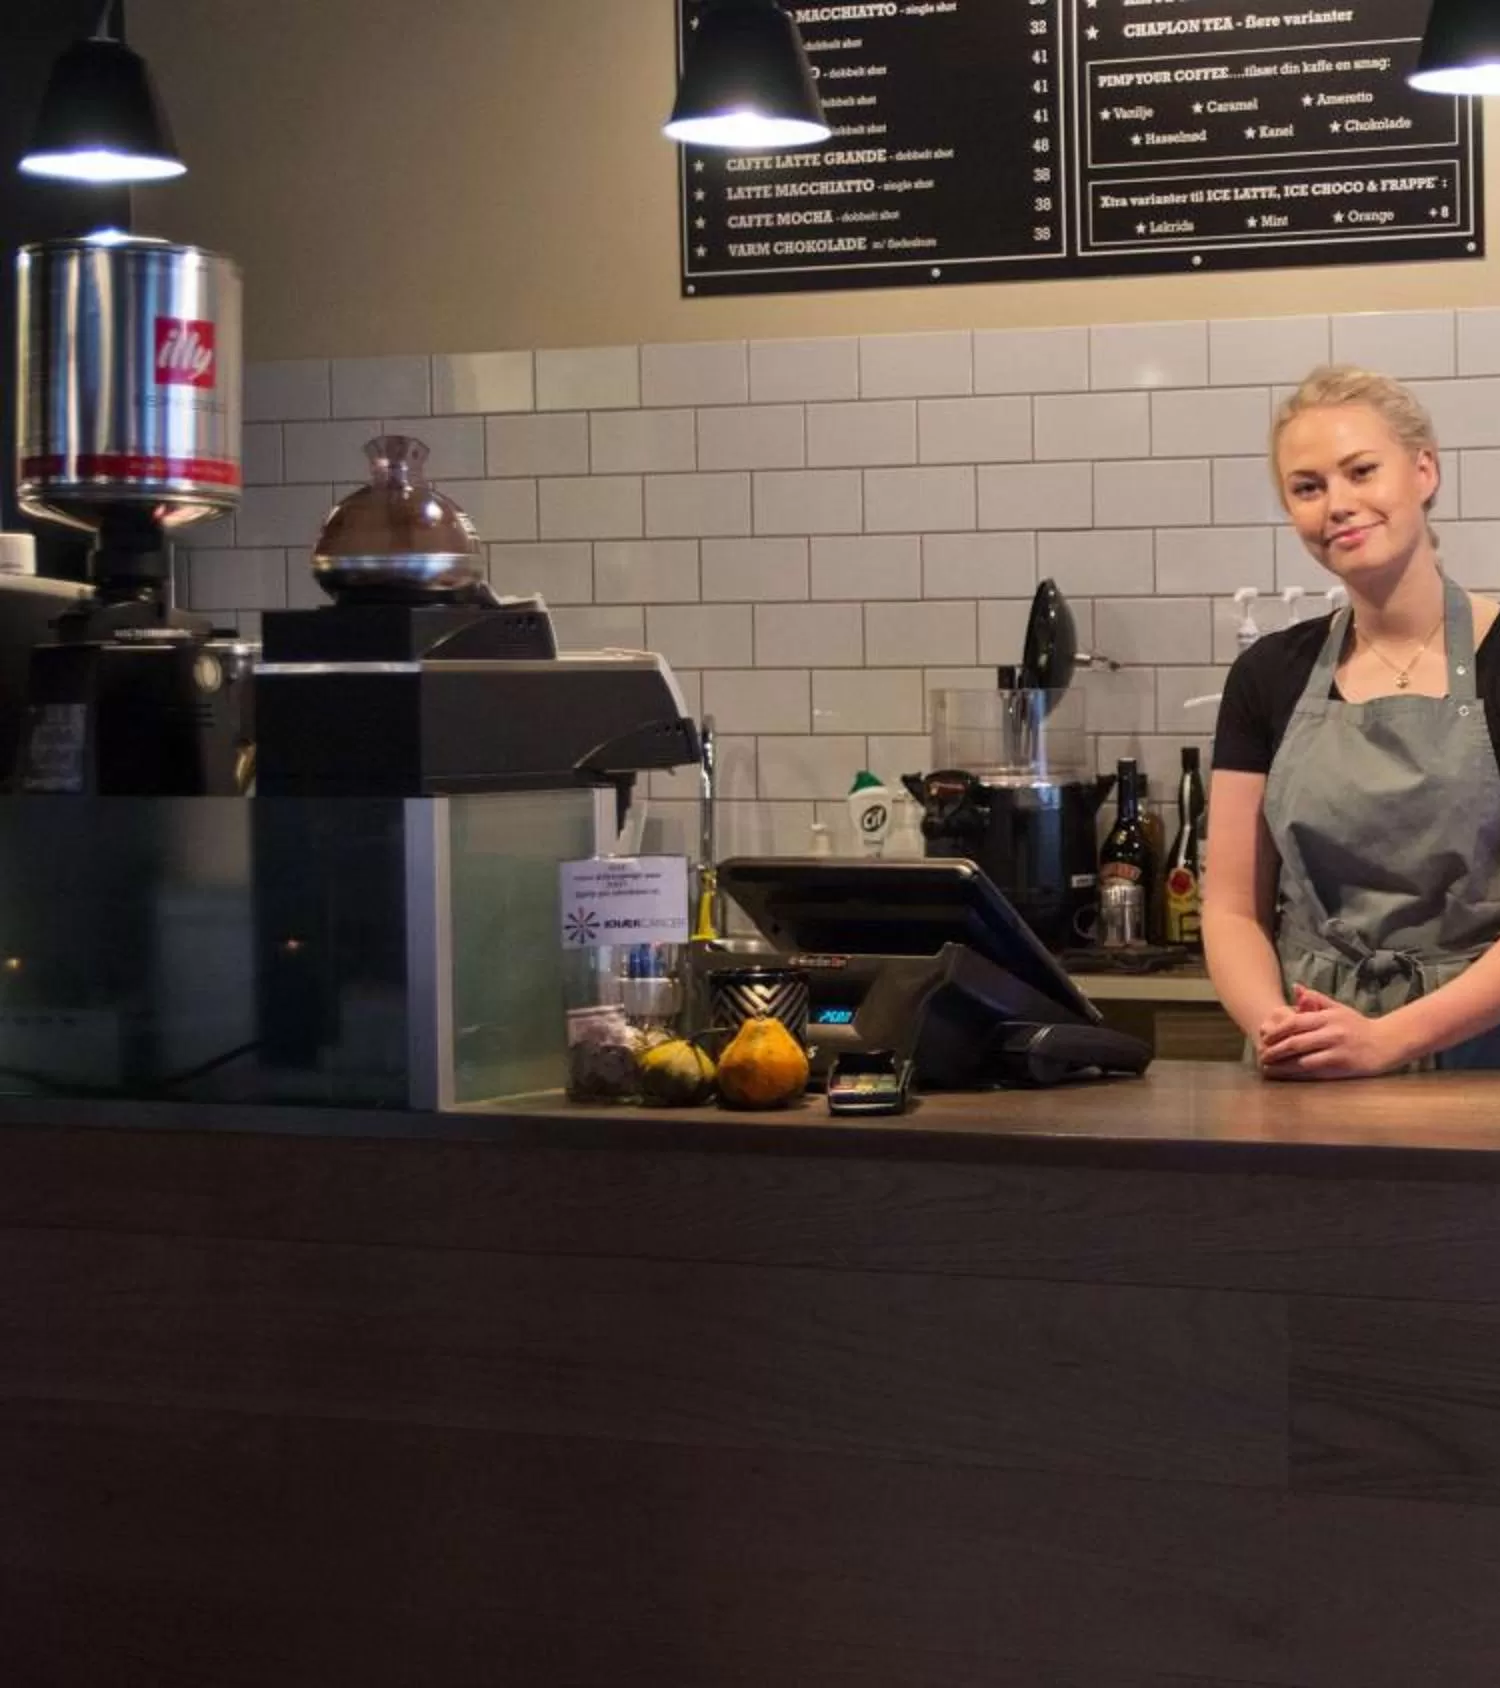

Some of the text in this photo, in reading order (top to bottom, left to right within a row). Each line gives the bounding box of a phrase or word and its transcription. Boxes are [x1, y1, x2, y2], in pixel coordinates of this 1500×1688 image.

[796, 3, 897, 23] MACCHIATTO
[936, 3, 957, 12] shot
[1030, 20, 1047, 35] 32
[1123, 20, 1200, 38] CHAPLON
[1203, 16, 1233, 31] TEA
[1245, 14, 1281, 29] flere
[1283, 10, 1353, 26] varianter
[1032, 50, 1047, 64] 41
[1098, 73, 1134, 88] PIMP
[1136, 71, 1171, 84] YOUR
[1280, 63, 1300, 75] din
[1302, 59, 1333, 74] kaffe
[1335, 61, 1351, 71] en
[1033, 79, 1048, 93] 41
[1113, 106, 1155, 121] Vanilje
[1206, 98, 1259, 113] Caramel
[1033, 108, 1049, 123] 41
[1258, 124, 1294, 139] Kanel
[1343, 116, 1413, 132] Chokolade
[726, 156, 773, 172] CAFFE
[775, 153, 821, 168] LATTE
[824, 149, 887, 165] GRANDE
[1032, 137, 1050, 152] 48
[726, 185, 772, 200] LATTE
[775, 179, 875, 197] MACCHIATTO
[1129, 193, 1189, 206] varianter
[1190, 190, 1205, 203] til
[1206, 188, 1232, 201] ICE
[1233, 185, 1281, 200] LATTE,
[1284, 183, 1309, 198] ICE
[1311, 181, 1364, 195] CHOCO
[1367, 180, 1379, 192] &
[727, 213, 774, 228] CAFFE
[776, 210, 834, 226] MOCHA
[1261, 215, 1289, 227] Mint
[1347, 209, 1395, 224] Orange
[728, 242, 771, 257] VARM
[773, 237, 867, 255] CHOKOLADE
[157, 328, 213, 381] illy
